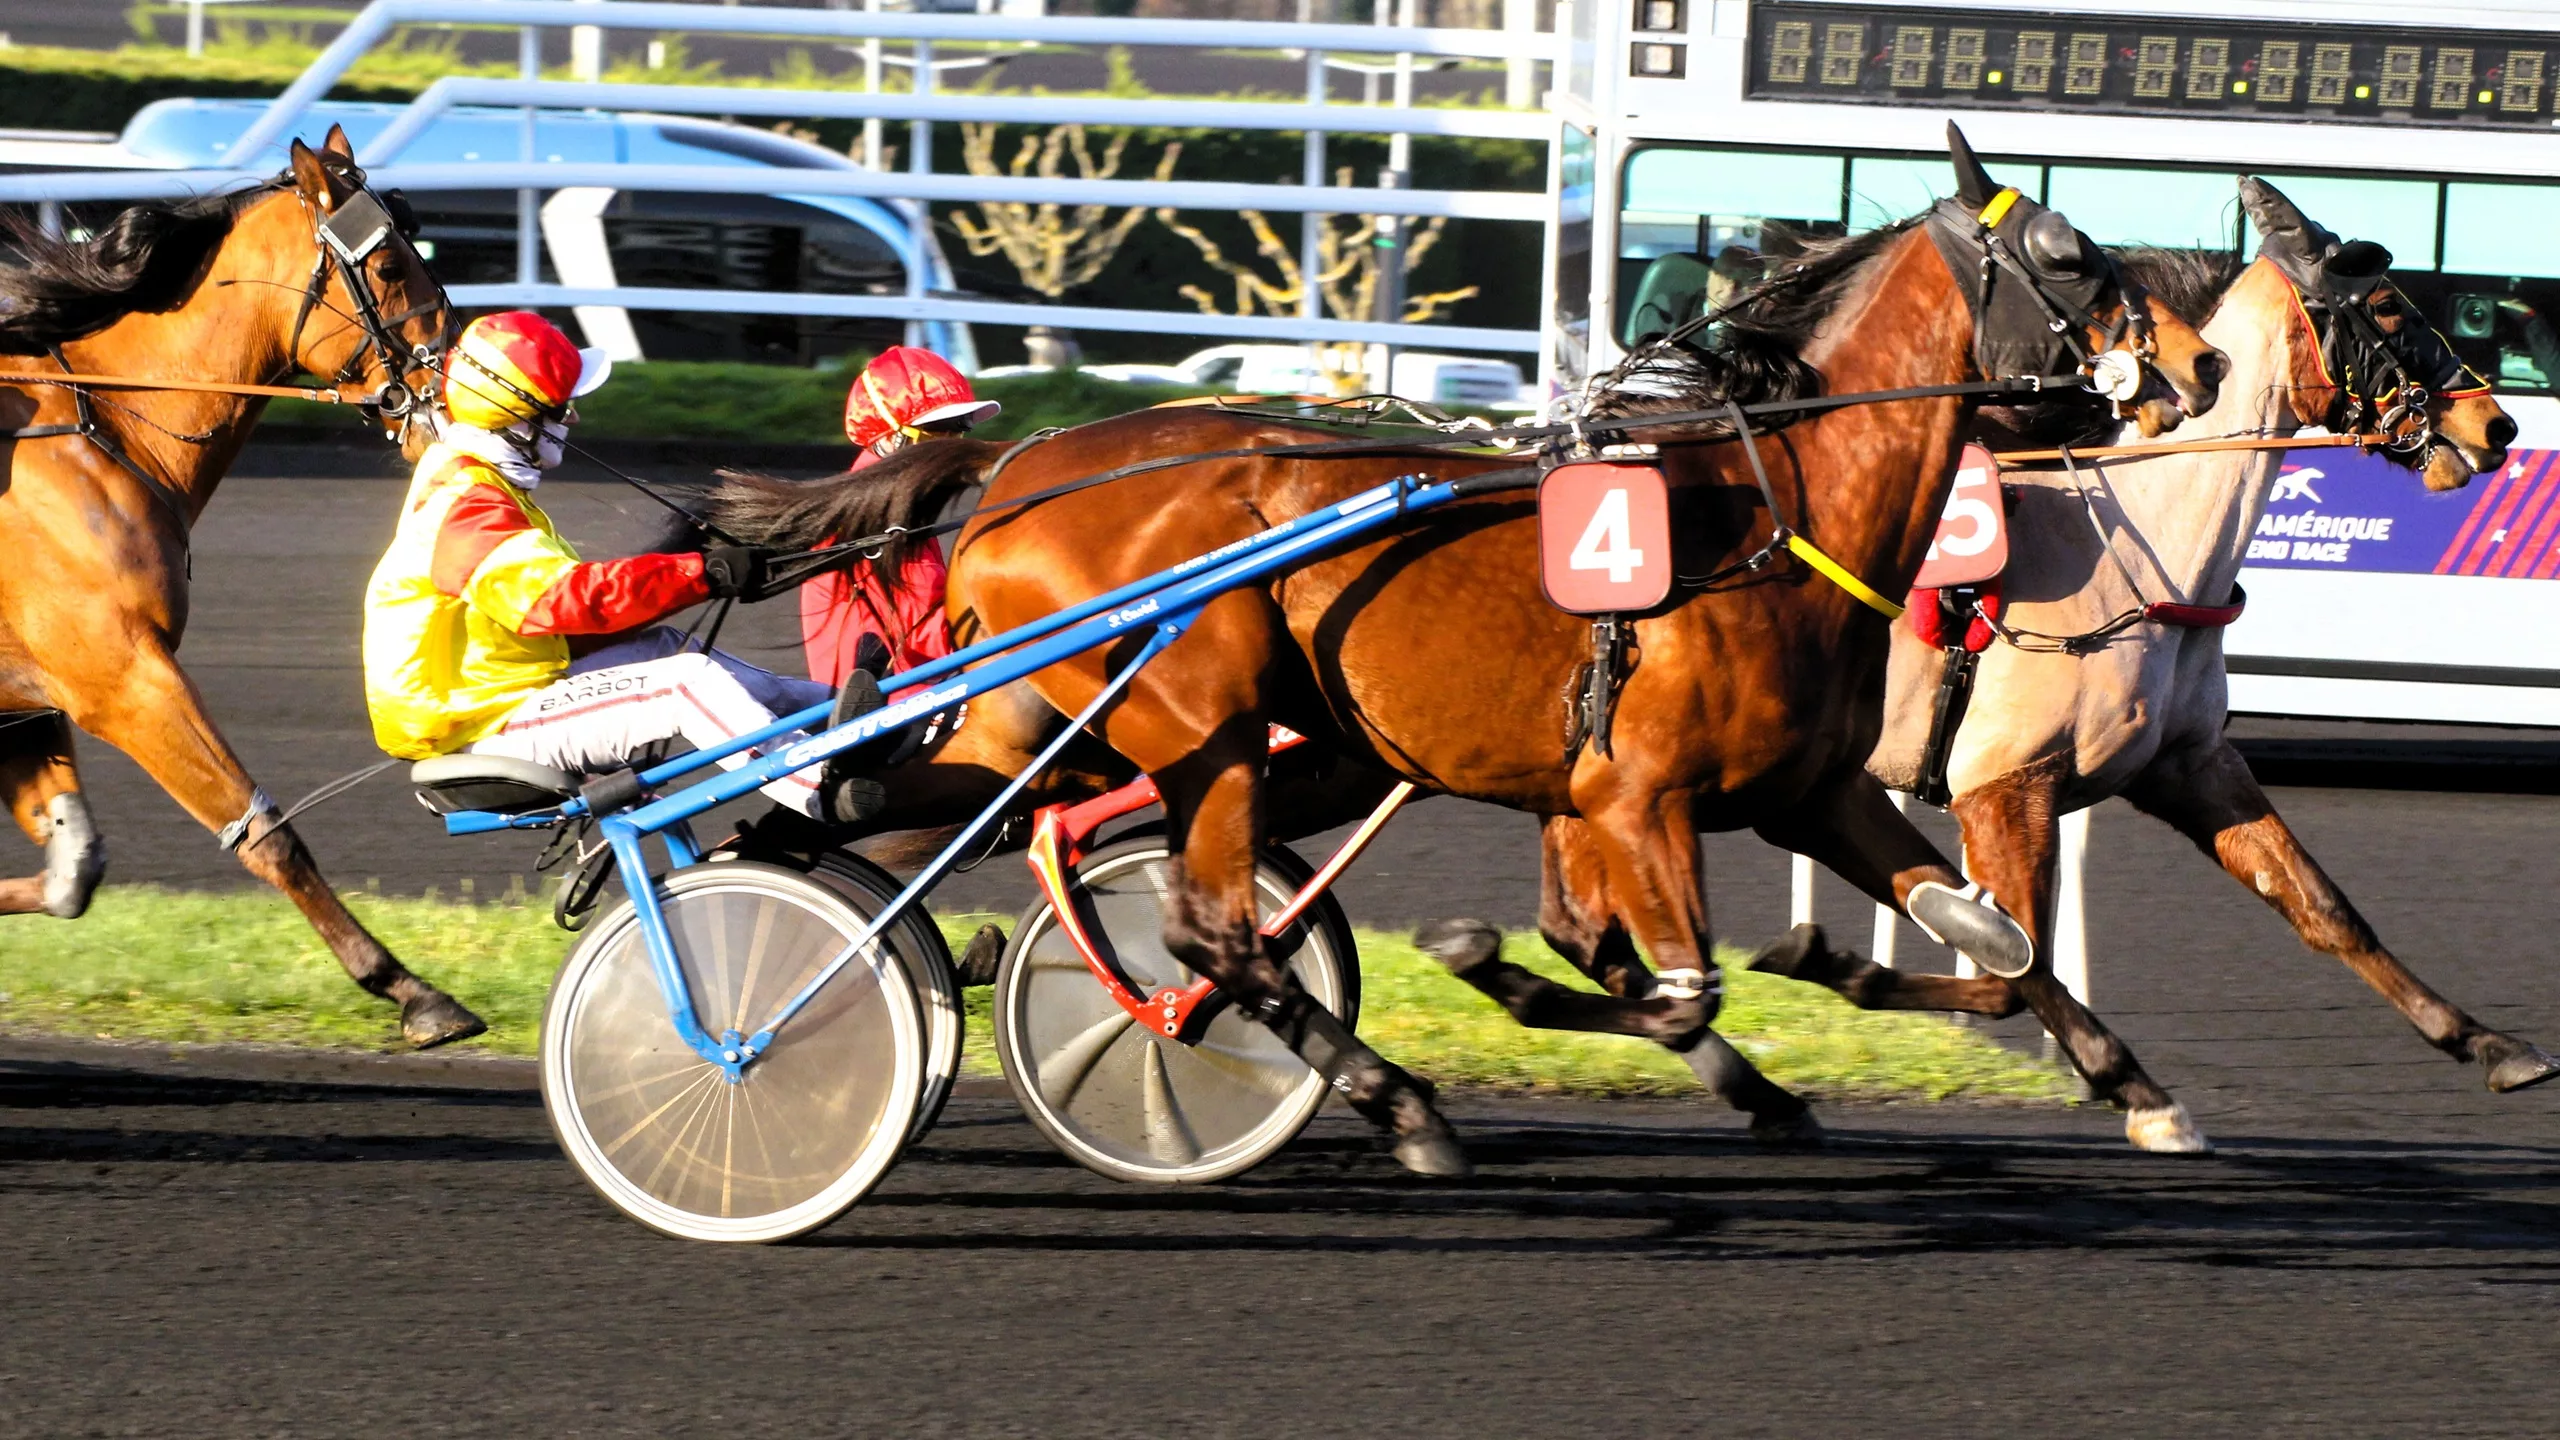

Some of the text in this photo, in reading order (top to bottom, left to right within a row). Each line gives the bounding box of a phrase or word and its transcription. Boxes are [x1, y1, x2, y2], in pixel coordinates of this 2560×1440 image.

[1569, 488, 1644, 583] 4
[2254, 509, 2394, 542] AMÉRIQUE
[2291, 541, 2351, 563] RACE
[540, 675, 648, 711] BARBOT
